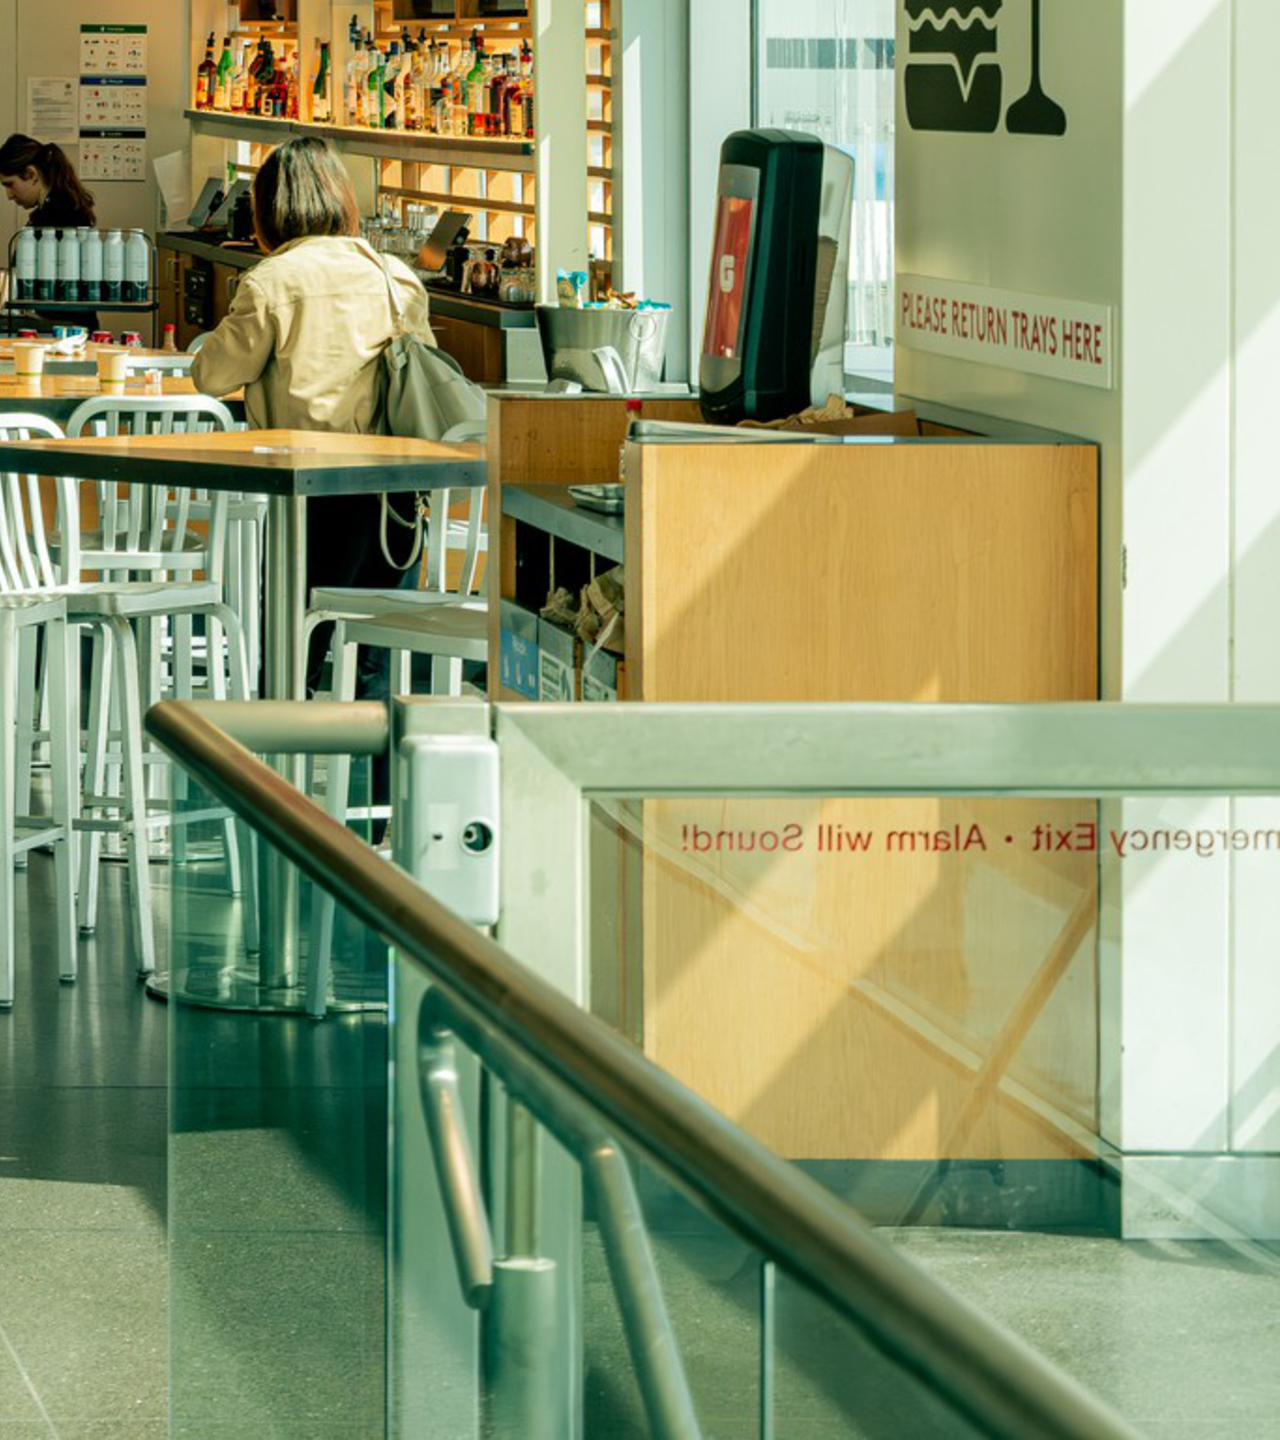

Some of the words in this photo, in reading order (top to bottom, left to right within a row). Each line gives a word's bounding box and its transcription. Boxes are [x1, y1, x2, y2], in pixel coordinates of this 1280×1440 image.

[719, 254, 736, 293] G
[902, 292, 947, 334] PLEASE
[952, 301, 1007, 345] RETURN
[1012, 311, 1057, 355] TRAYS
[1062, 319, 1102, 364] HERE
